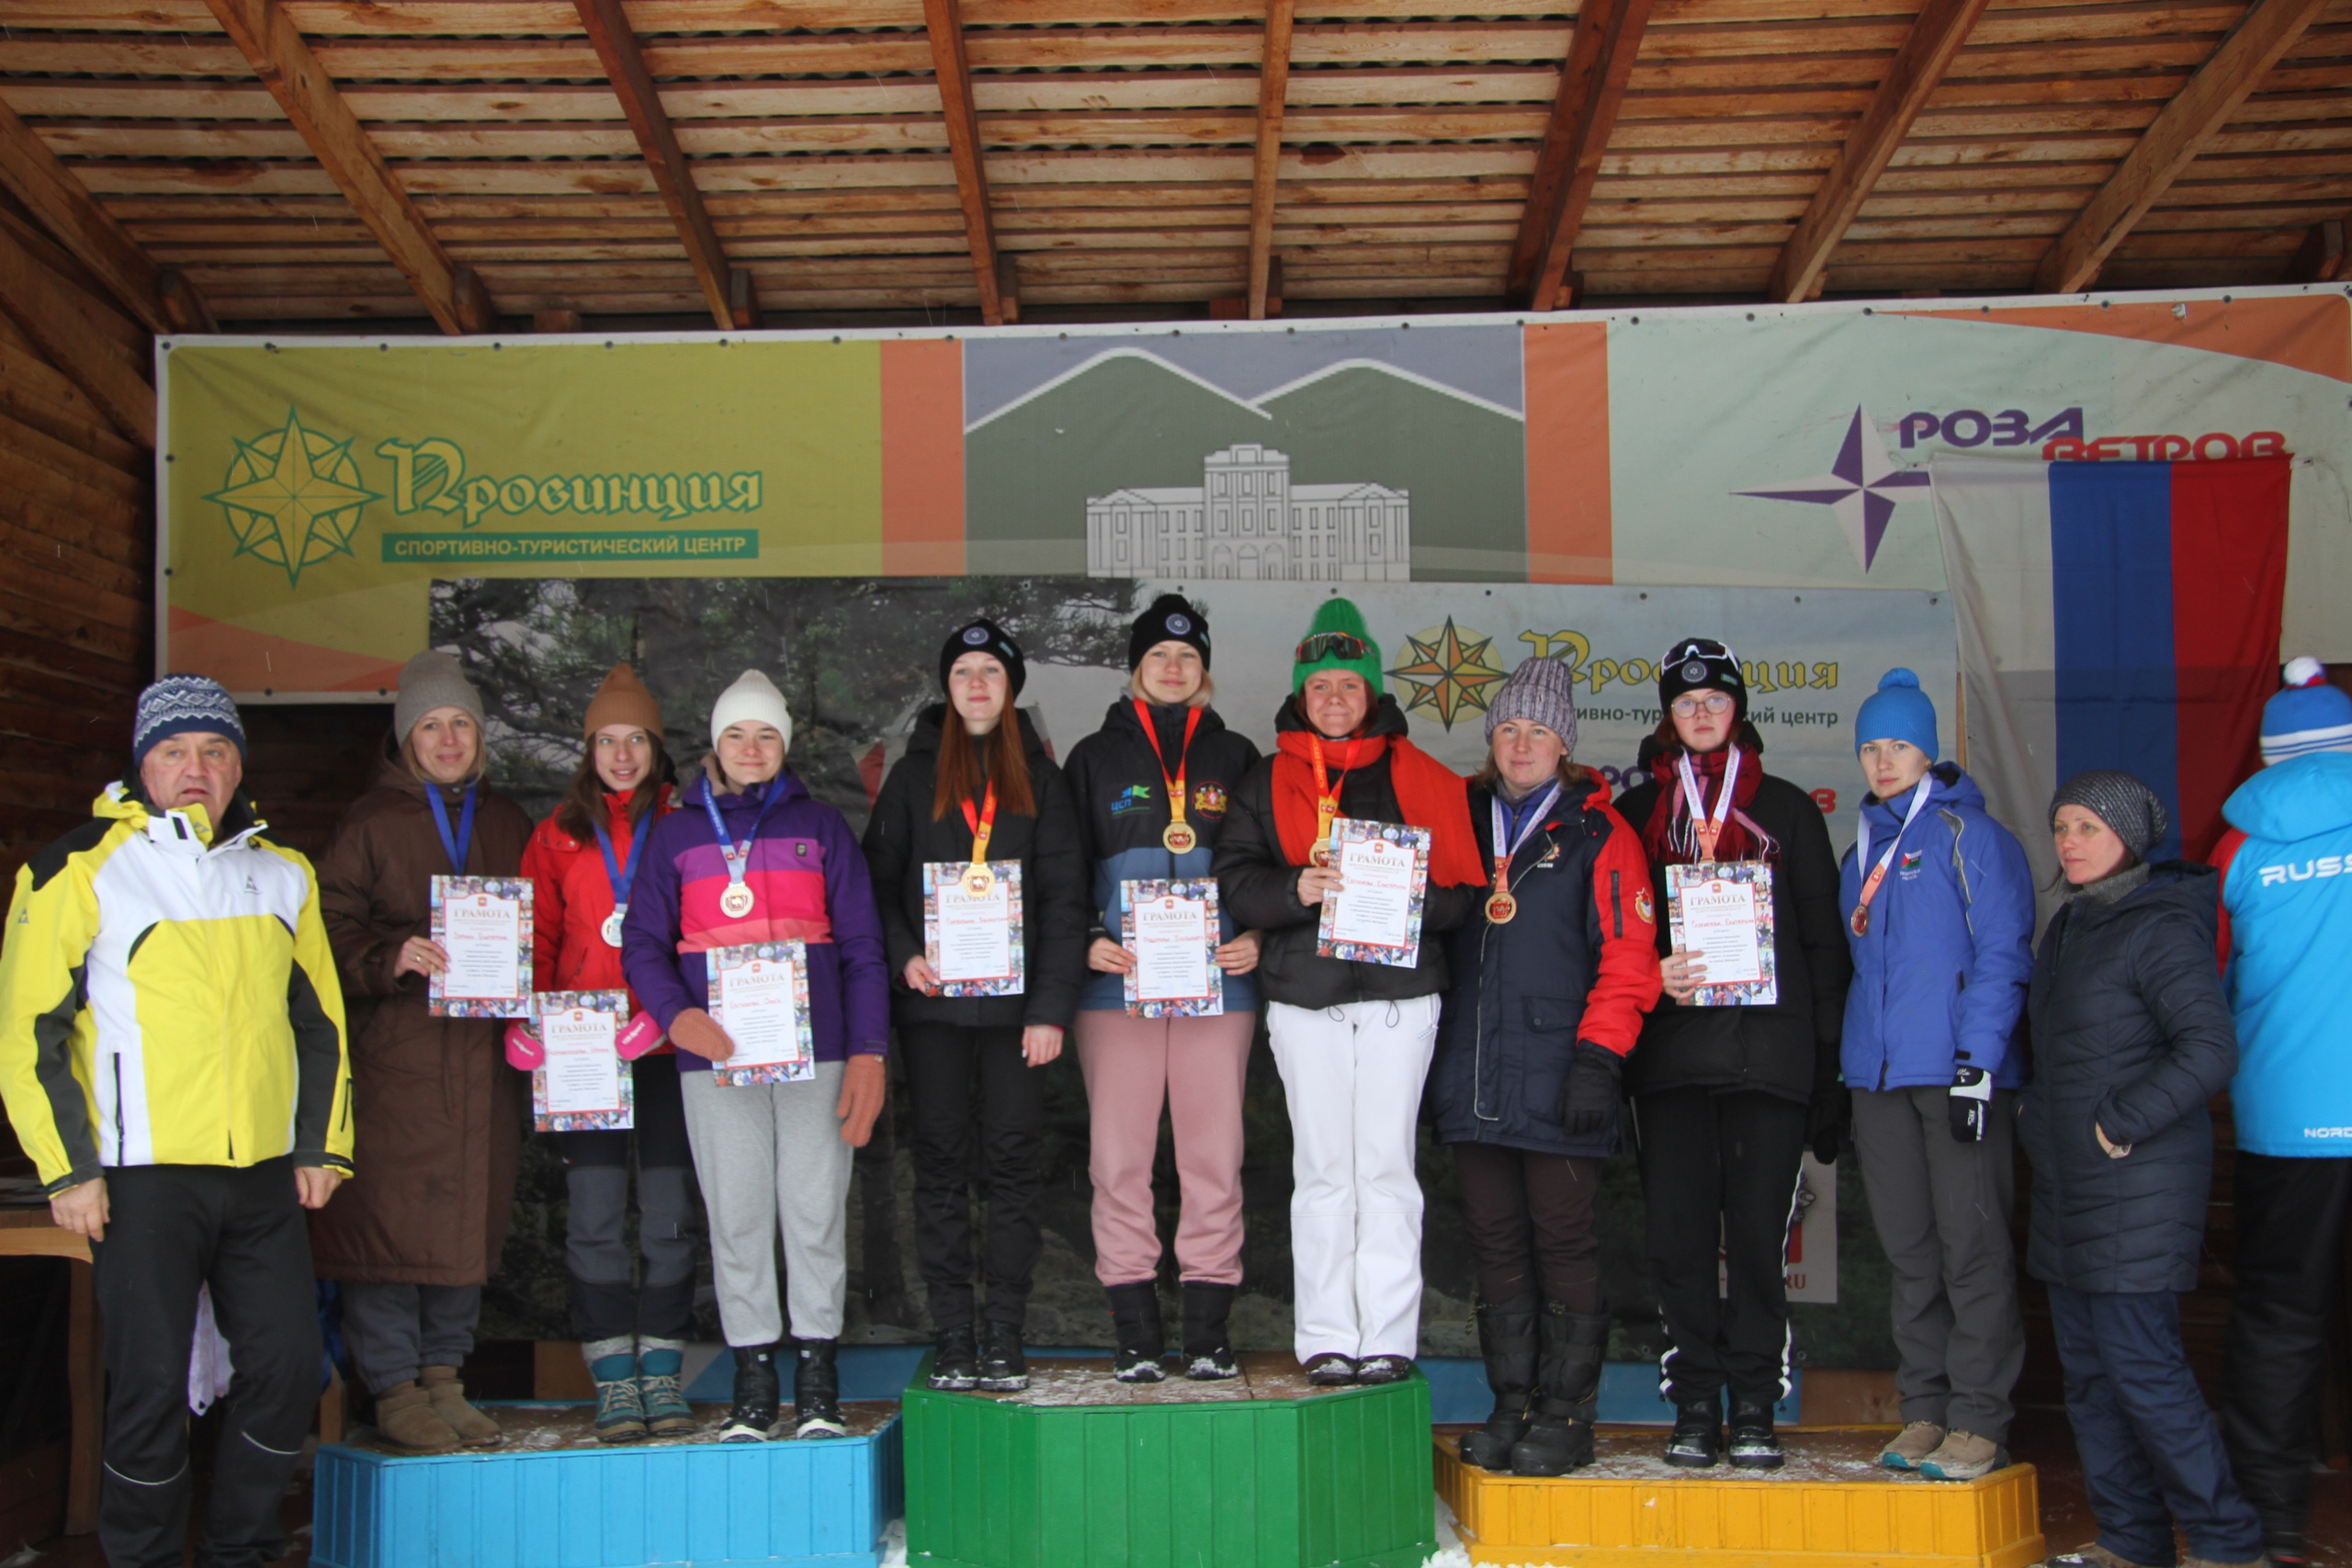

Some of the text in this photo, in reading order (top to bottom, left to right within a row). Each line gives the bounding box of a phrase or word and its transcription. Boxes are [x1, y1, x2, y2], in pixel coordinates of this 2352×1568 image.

[1899, 406, 2085, 449] РОЗА
[375, 436, 763, 529] Провинция
[394, 536, 747, 557] СПОРТИВНО-ТУРИСТИЧЕСКИЙ ЦЕНТР
[1518, 629, 1838, 695] Проция
[1781, 711, 1838, 728] центр
[1110, 797, 1133, 811] ЦСП
[1350, 853, 1406, 868] ГРАМОТА
[945, 893, 1001, 905] ГРАМОТА
[1689, 894, 1747, 907] ГРАМОТА
[452, 908, 512, 919] ГРАМОТА
[1141, 911, 1198, 921] ГРАМОТА
[729, 972, 786, 988] ГРАМОТА
[550, 1022, 608, 1034] ГРАМОТА
